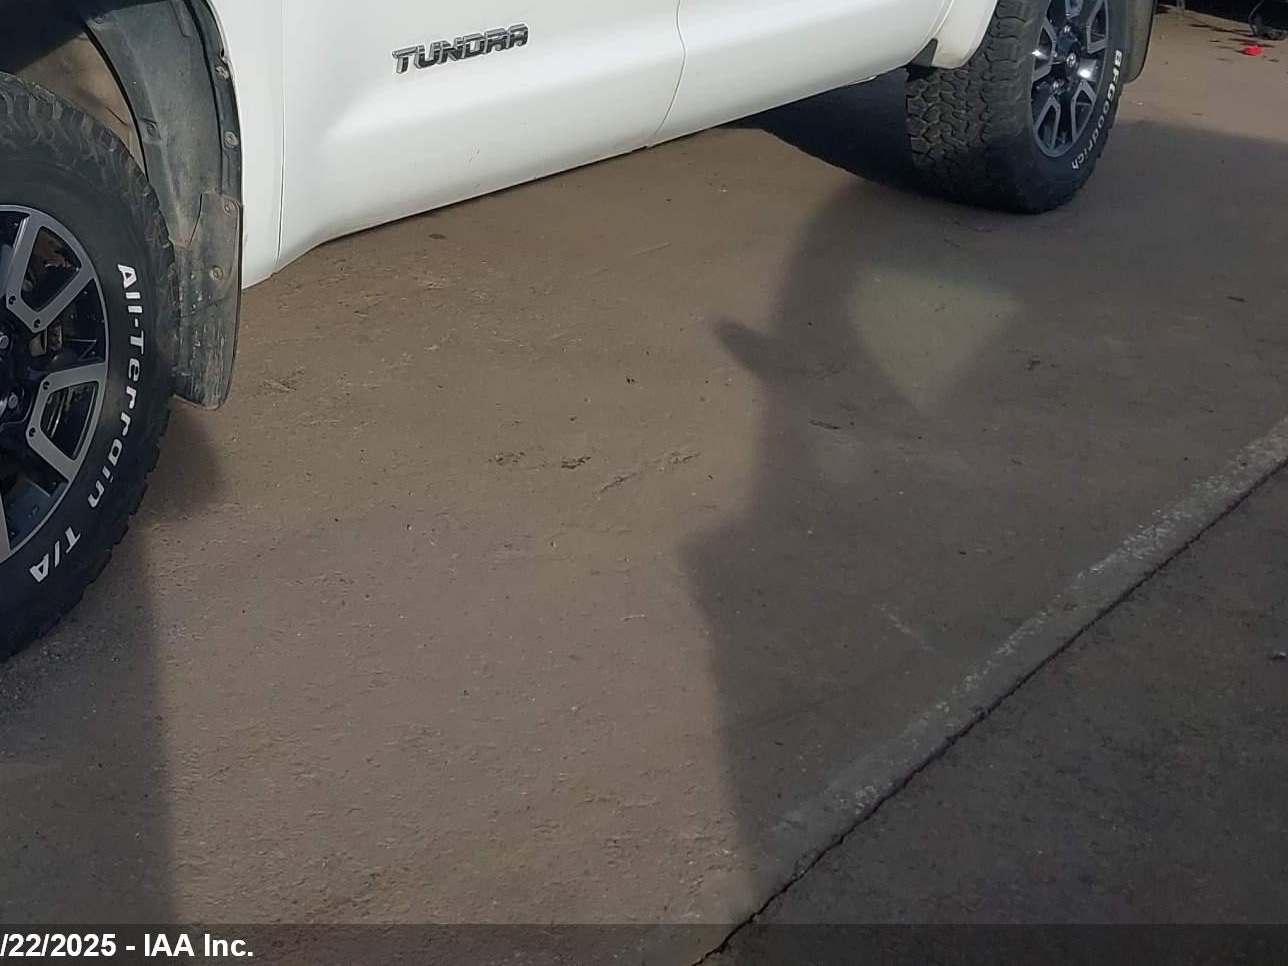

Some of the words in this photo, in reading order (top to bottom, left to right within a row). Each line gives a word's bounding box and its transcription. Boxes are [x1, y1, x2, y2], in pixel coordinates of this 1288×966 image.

[392, 23, 528, 74] TUNDRA
[88, 263, 146, 509] All-Terrain
[29, 525, 81, 584] T/A
